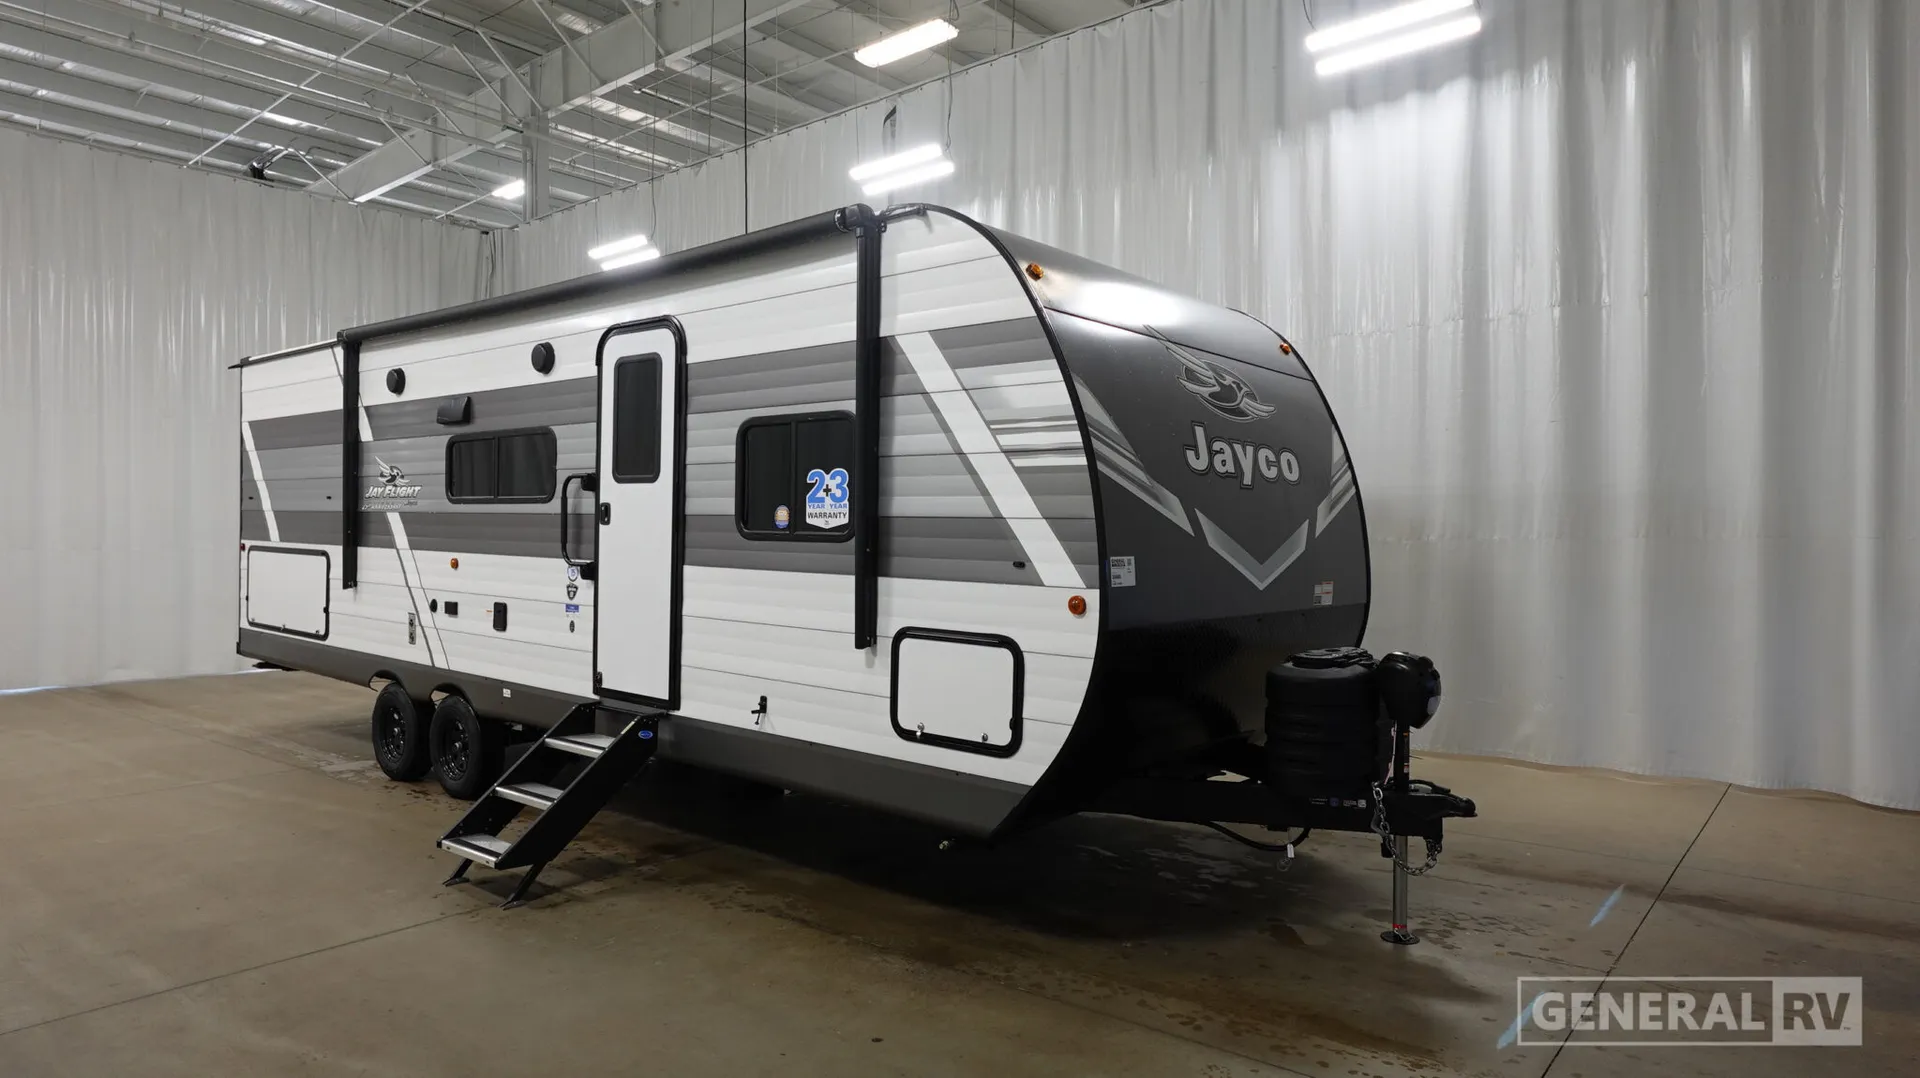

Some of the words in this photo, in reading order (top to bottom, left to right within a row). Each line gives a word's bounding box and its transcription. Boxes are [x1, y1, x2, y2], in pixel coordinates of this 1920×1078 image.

[1184, 422, 1300, 488] Jayco
[365, 486, 384, 499] JAY
[384, 485, 422, 499] FLIGHT
